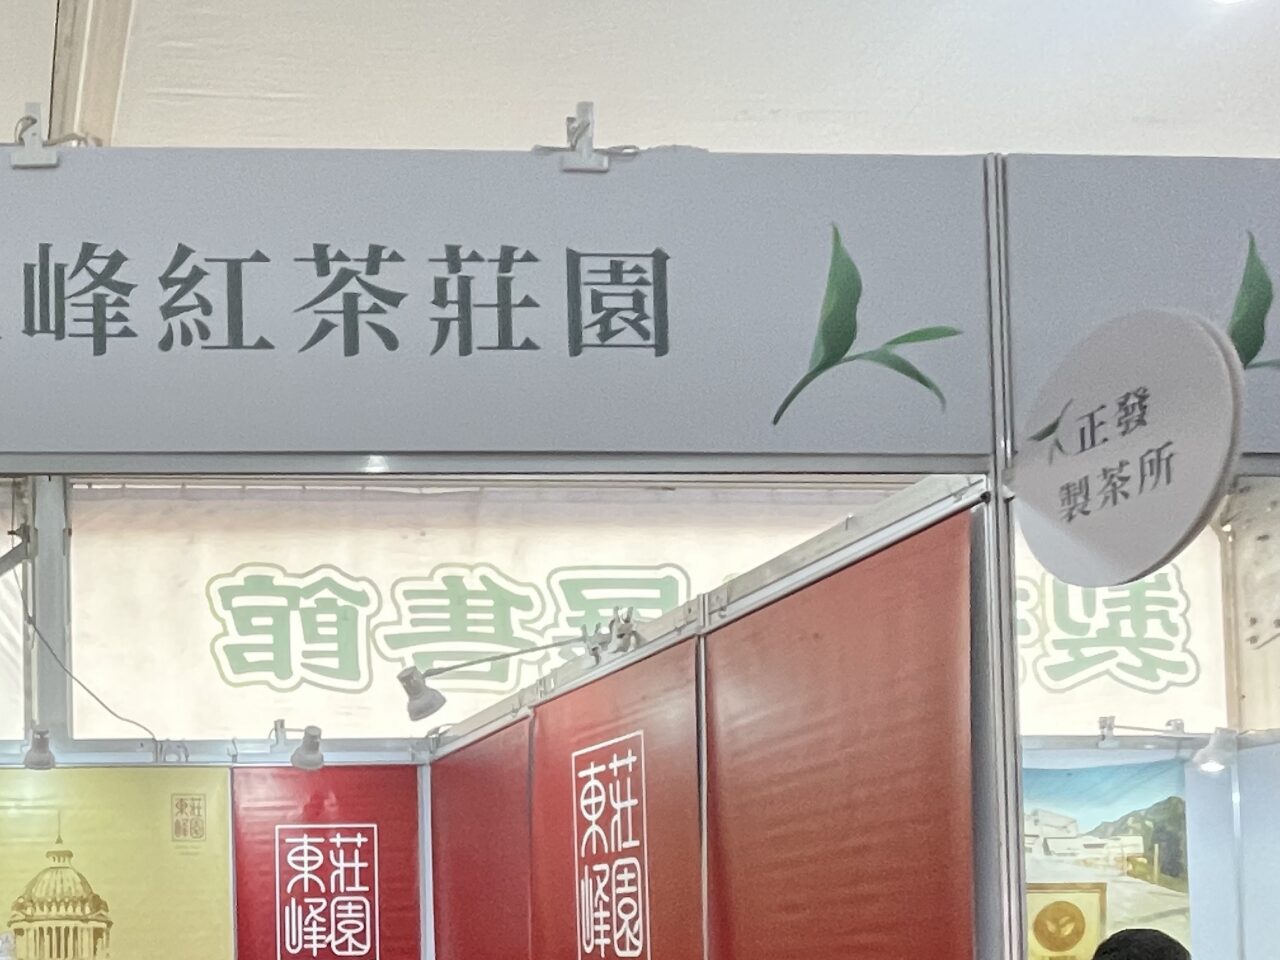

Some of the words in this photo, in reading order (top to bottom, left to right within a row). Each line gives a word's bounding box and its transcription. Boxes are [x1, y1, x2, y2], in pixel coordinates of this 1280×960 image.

[1075, 386, 1153, 455] 正發
[1058, 441, 1177, 524] 製茶所
